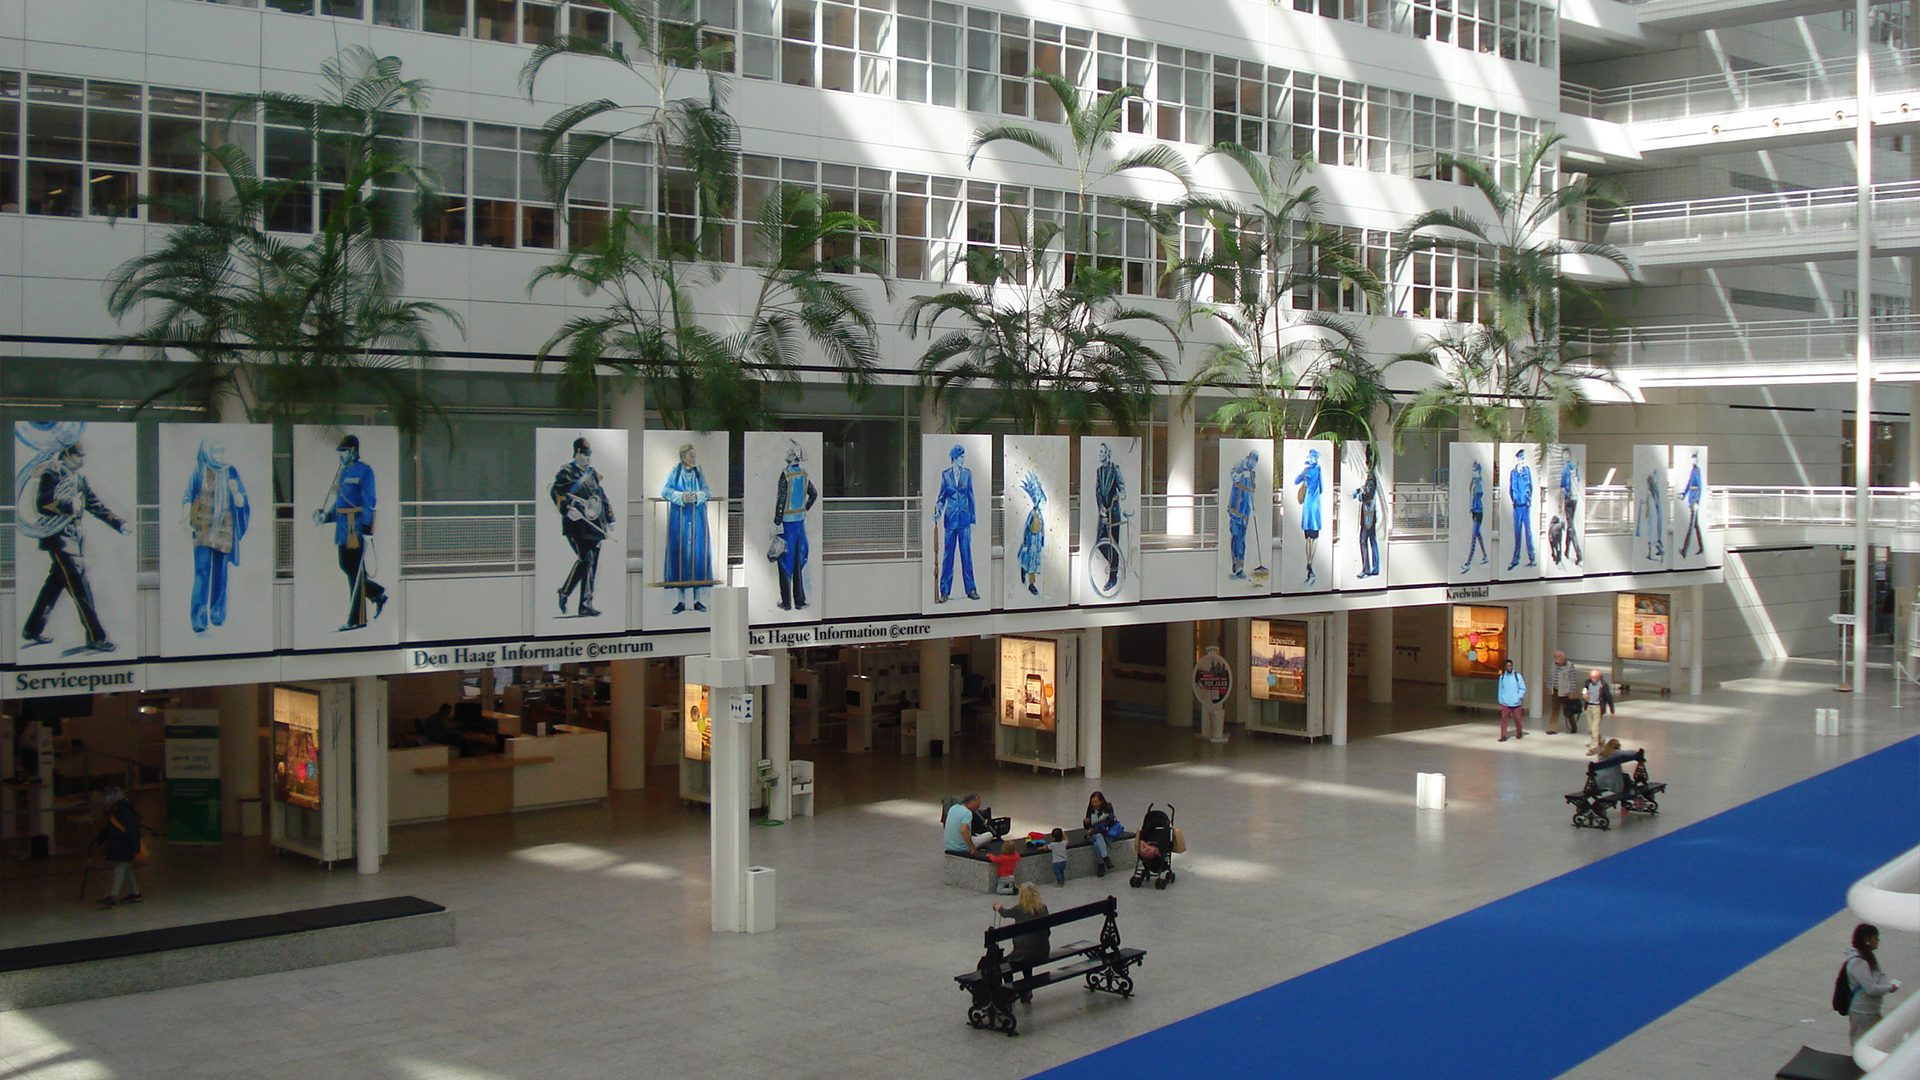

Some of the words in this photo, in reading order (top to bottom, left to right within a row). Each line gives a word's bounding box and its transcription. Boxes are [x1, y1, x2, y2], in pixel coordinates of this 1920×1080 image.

[749, 631, 765, 645] he
[768, 629, 811, 647] Hague
[814, 624, 887, 641] Information
[413, 650, 448, 668] Den
[454, 647, 496, 667] Haag
[501, 641, 583, 661] Informatie
[16, 671, 134, 691] Servicepunt
